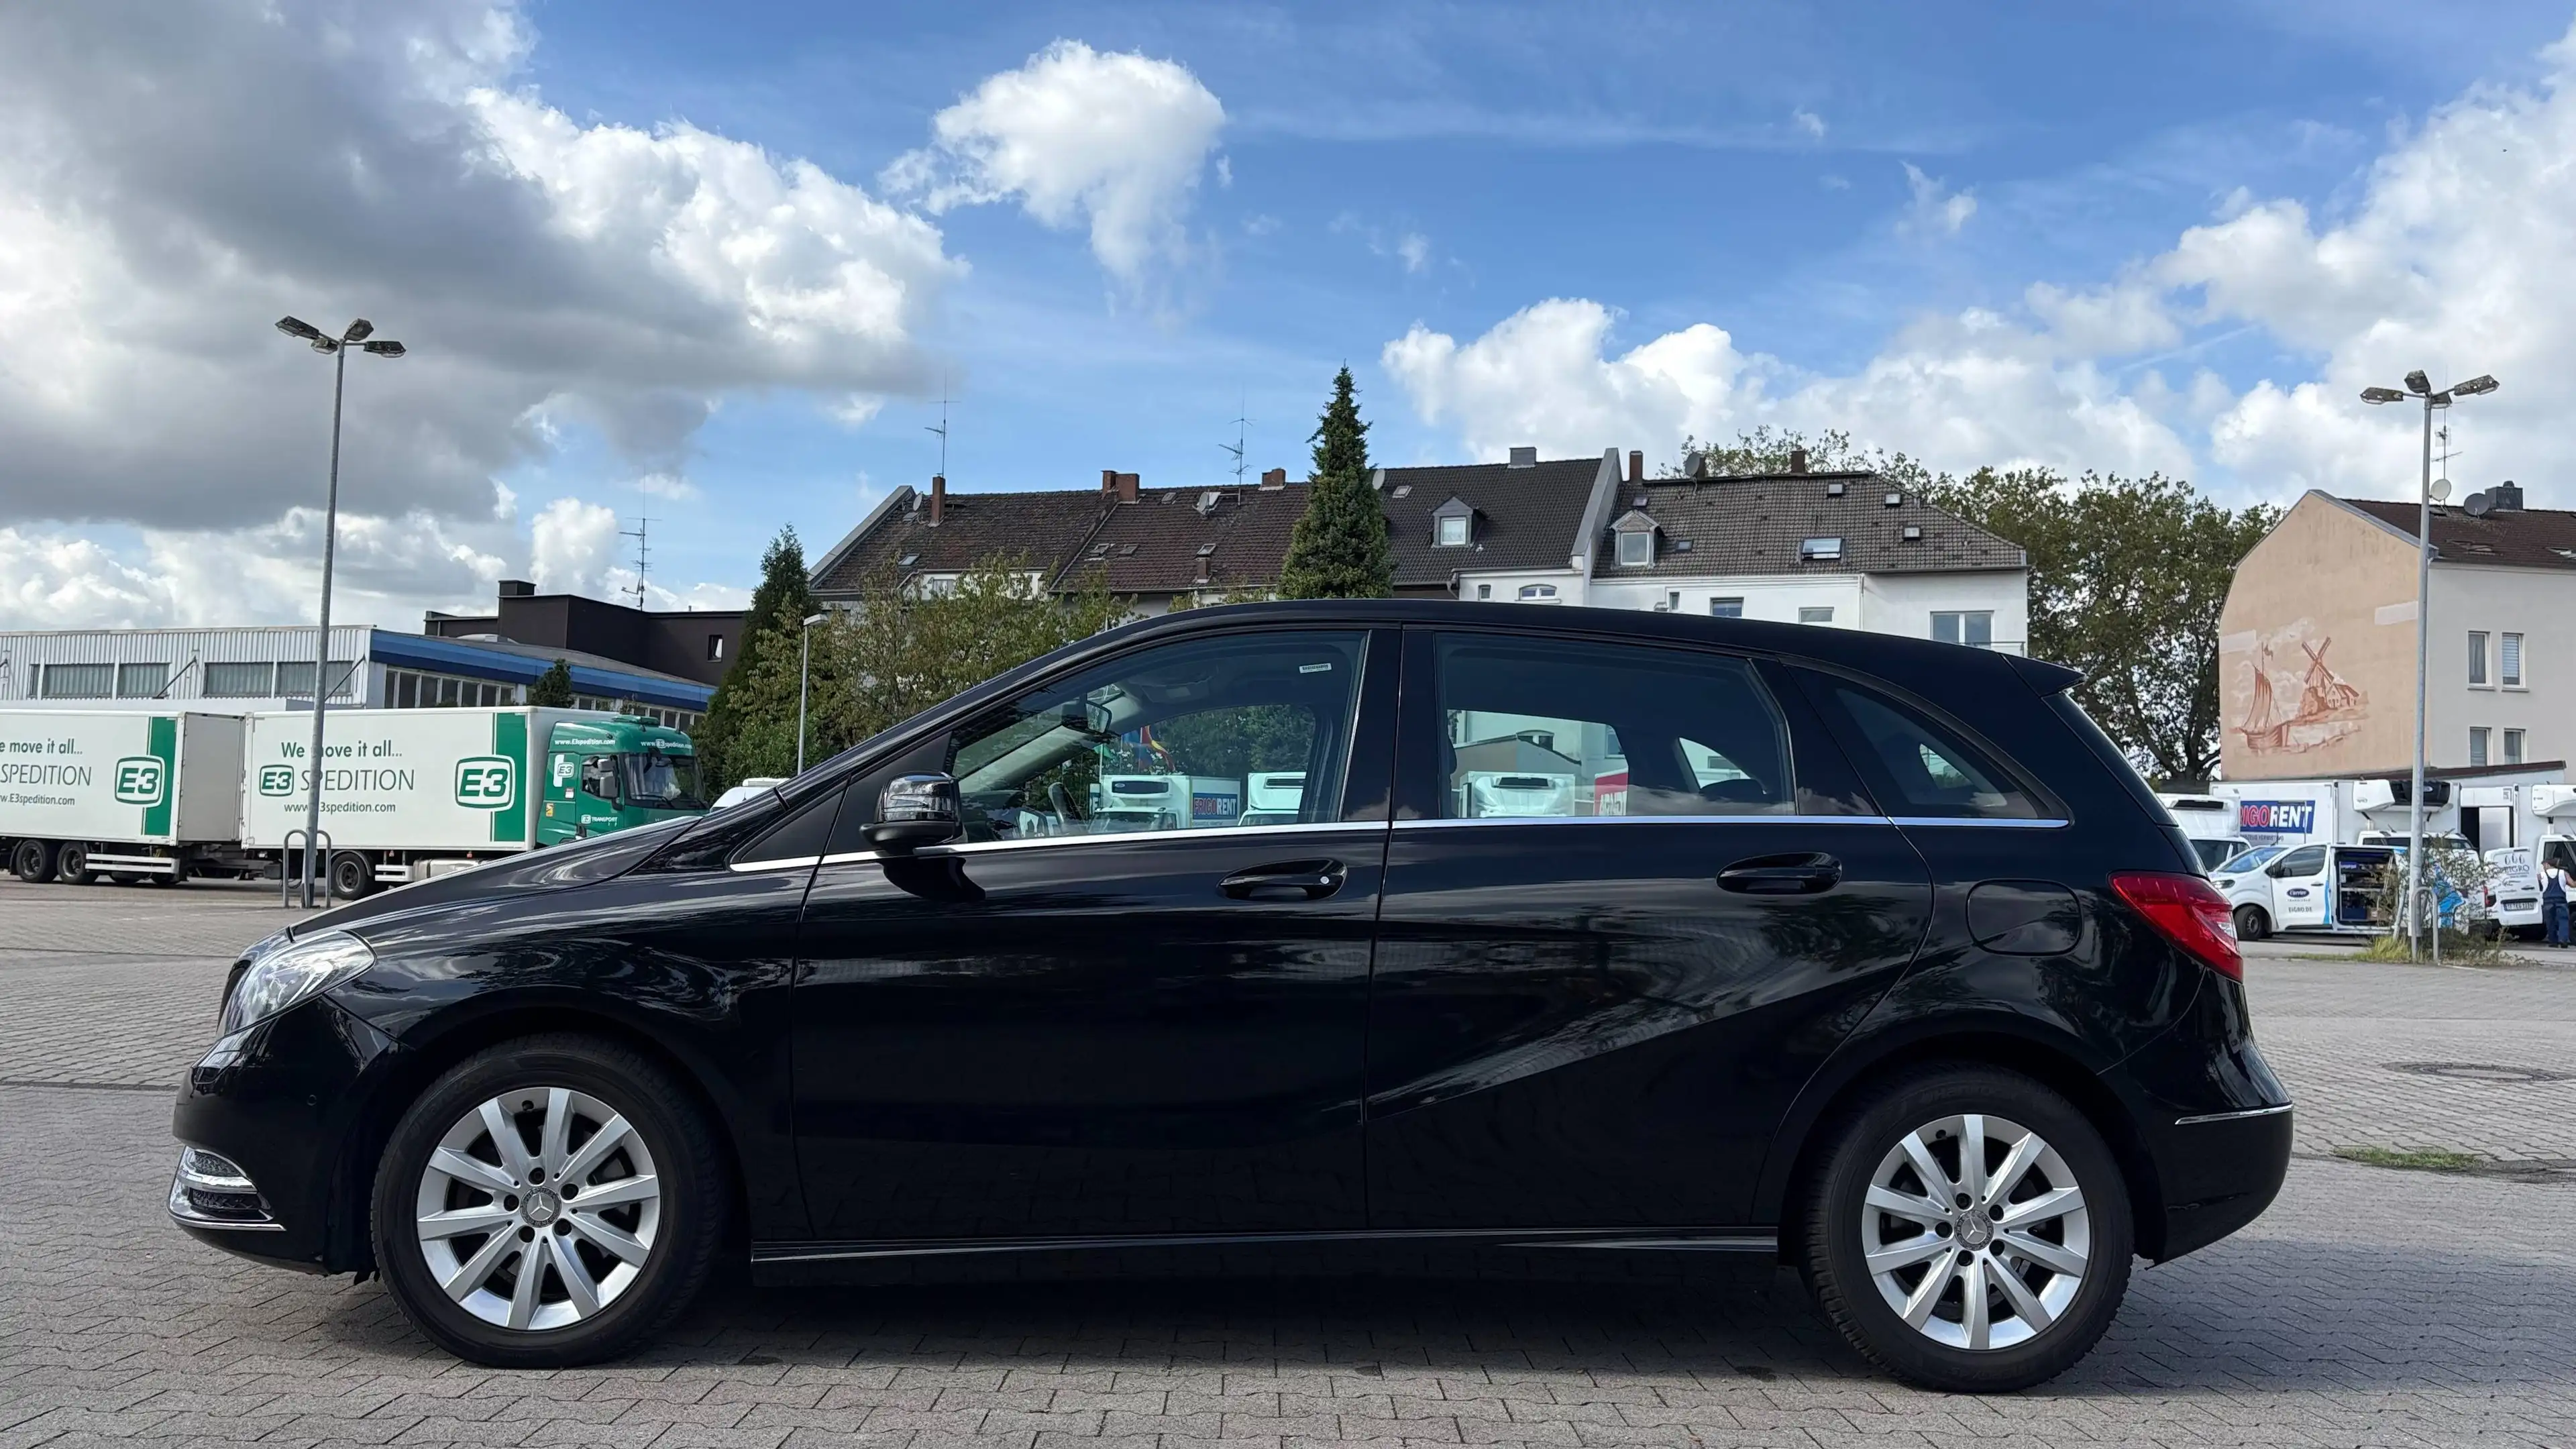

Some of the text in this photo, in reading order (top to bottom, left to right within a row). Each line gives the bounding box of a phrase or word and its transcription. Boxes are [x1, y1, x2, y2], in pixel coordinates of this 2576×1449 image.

[9, 741, 43, 753] move
[47, 738, 55, 753] it
[58, 739, 83, 755] all...
[281, 740, 402, 757] We ove it all...
[0, 763, 92, 786] SPEDITION
[558, 765, 572, 775] E3
[117, 767, 159, 794] E3
[262, 771, 292, 790] E3
[459, 768, 508, 797] E3
[0, 793, 75, 806] w.E3spedition.com
[284, 802, 396, 815] www3spedition.com
